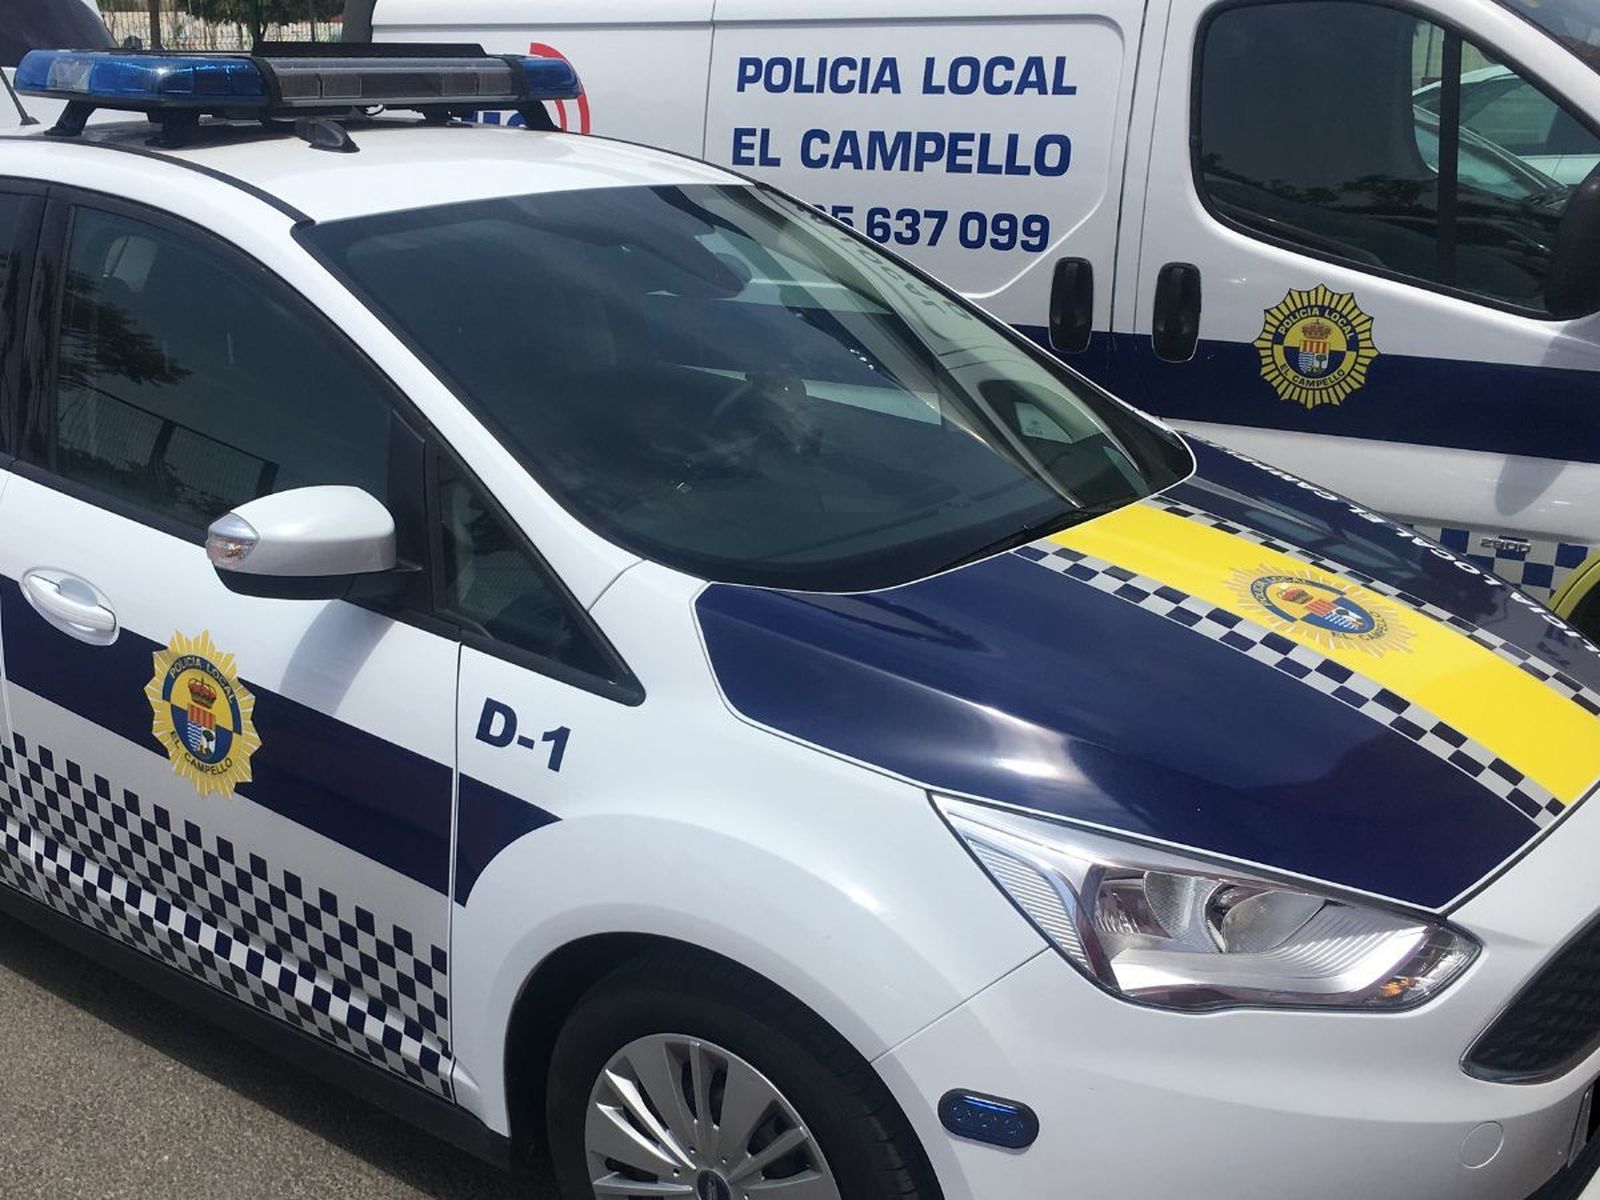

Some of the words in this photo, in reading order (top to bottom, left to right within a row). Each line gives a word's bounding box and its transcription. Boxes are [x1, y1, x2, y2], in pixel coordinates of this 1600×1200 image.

[736, 56, 901, 94] POLICIA
[922, 55, 1077, 95] LOCAL
[732, 127, 781, 167] EL
[800, 128, 1071, 177] CAMPELLO
[866, 207, 948, 246] 637
[959, 211, 1050, 252] 099
[1278, 307, 1320, 335] POLICIA
[1324, 309, 1355, 341] LOCAL
[1279, 363, 1290, 378] EL
[1292, 369, 1346, 389] CAMPELLO
[1396, 527, 1502, 585] LOCAL
[1510, 592, 1600, 658] LICIA
[169, 656, 202, 680] POLICIA
[206, 663, 235, 703] LOCAL
[170, 730, 180, 750] EL
[184, 752, 234, 776] CAMPELLO
[475, 697, 571, 773] D-1
